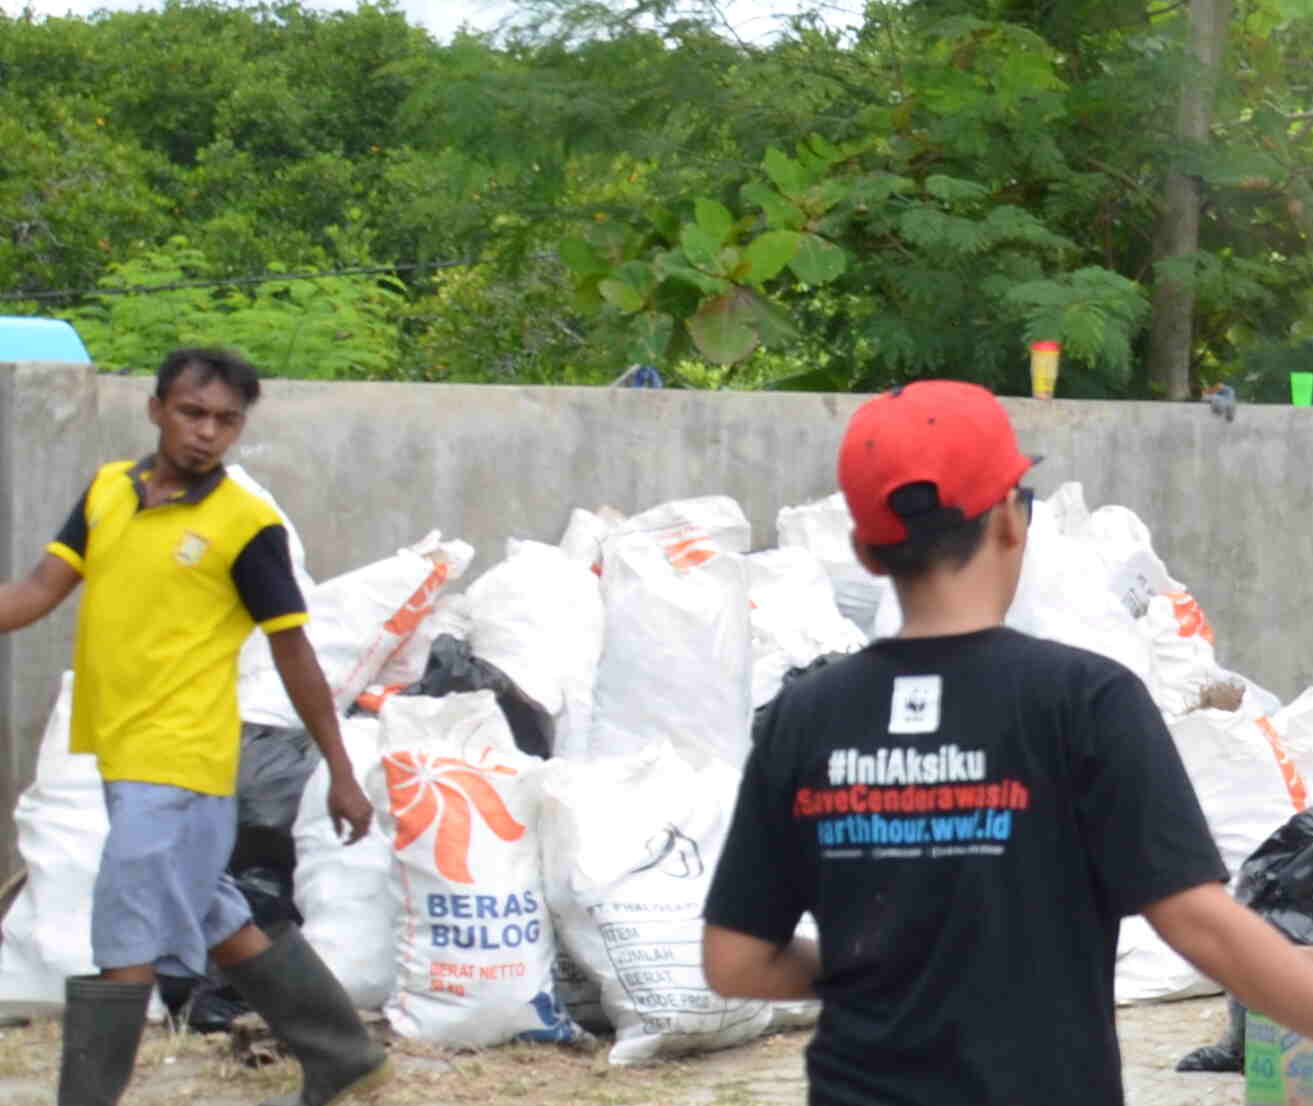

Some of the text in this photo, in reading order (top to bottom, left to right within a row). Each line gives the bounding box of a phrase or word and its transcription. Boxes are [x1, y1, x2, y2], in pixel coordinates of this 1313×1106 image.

[827, 744, 986, 785] #IniAksiku
[426, 889, 539, 919] BERAS
[430, 919, 540, 949] BULOG
[624, 969, 672, 987] BERAT
